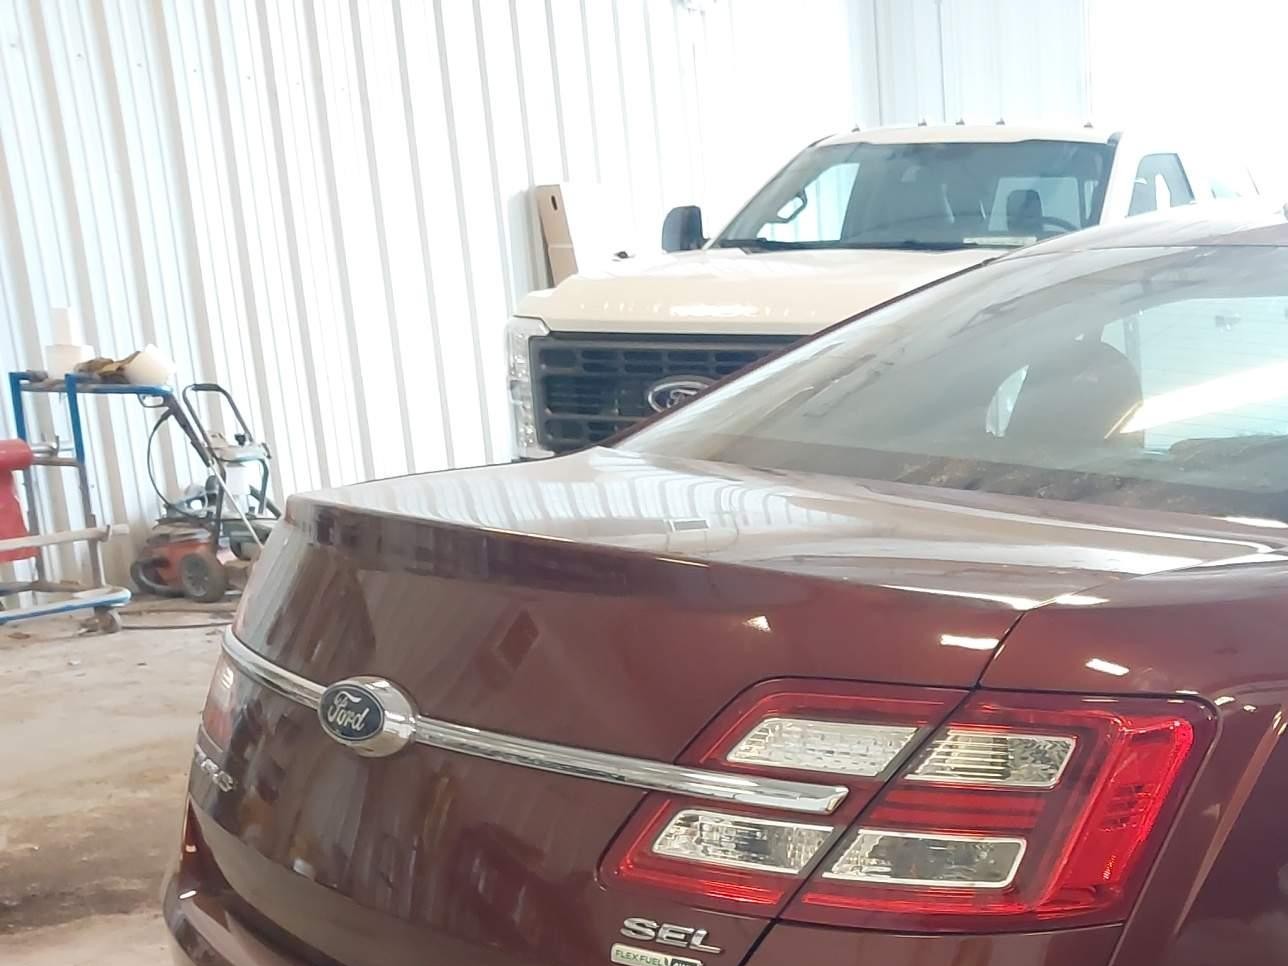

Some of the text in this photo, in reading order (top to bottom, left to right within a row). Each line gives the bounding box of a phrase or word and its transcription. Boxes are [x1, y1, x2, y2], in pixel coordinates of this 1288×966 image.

[327, 690, 371, 732] Ford
[620, 917, 721, 954] SEL
[615, 949, 641, 961] FLEX
[640, 954, 665, 966] FUEL
